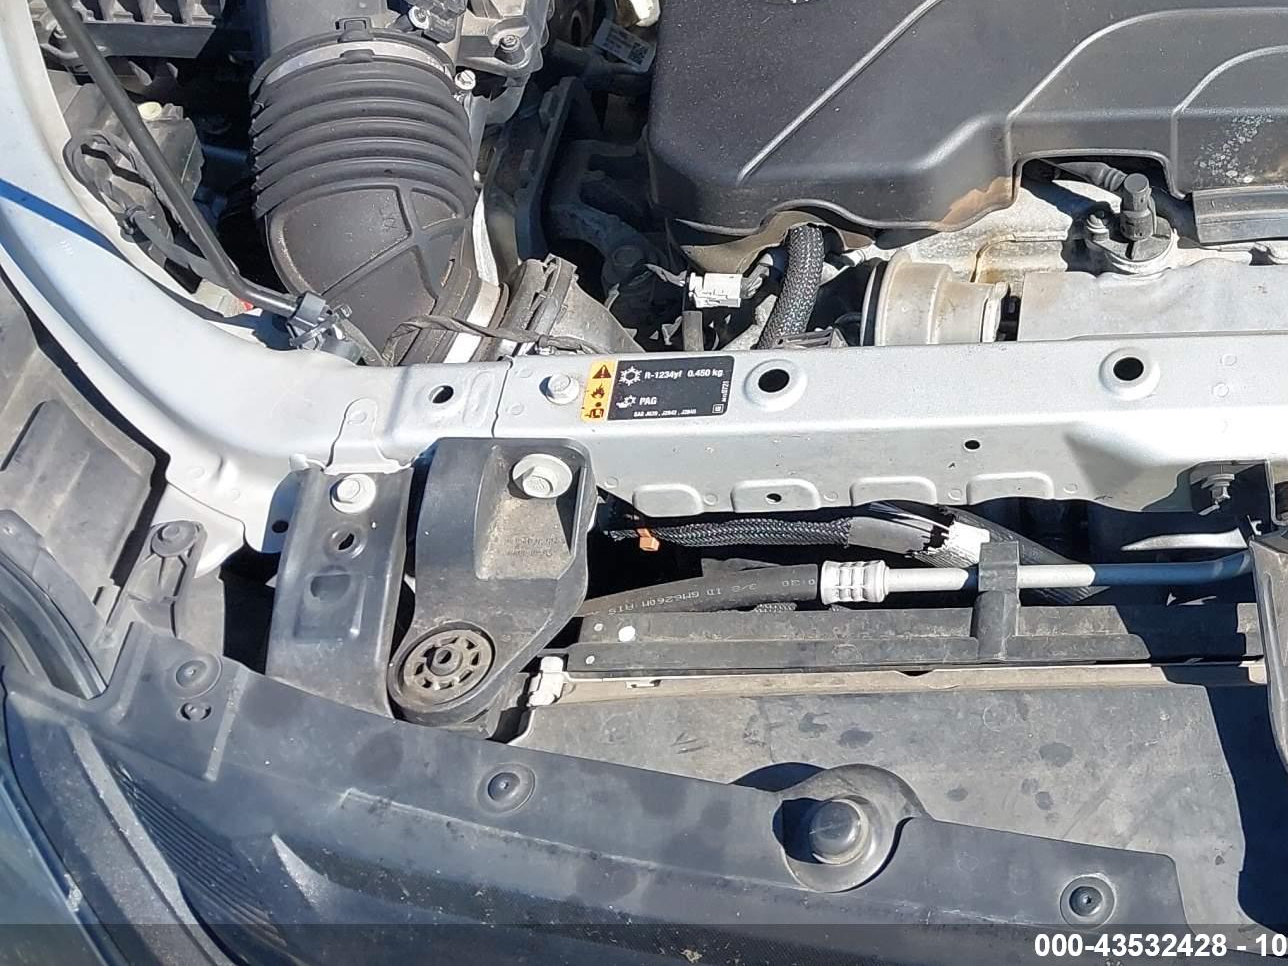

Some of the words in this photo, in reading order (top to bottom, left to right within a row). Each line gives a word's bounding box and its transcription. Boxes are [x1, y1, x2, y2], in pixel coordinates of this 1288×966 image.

[644, 370, 683, 380] R-1234yf
[687, 369, 711, 378] 0.450
[711, 368, 724, 378] kg
[639, 396, 657, 406] PAG
